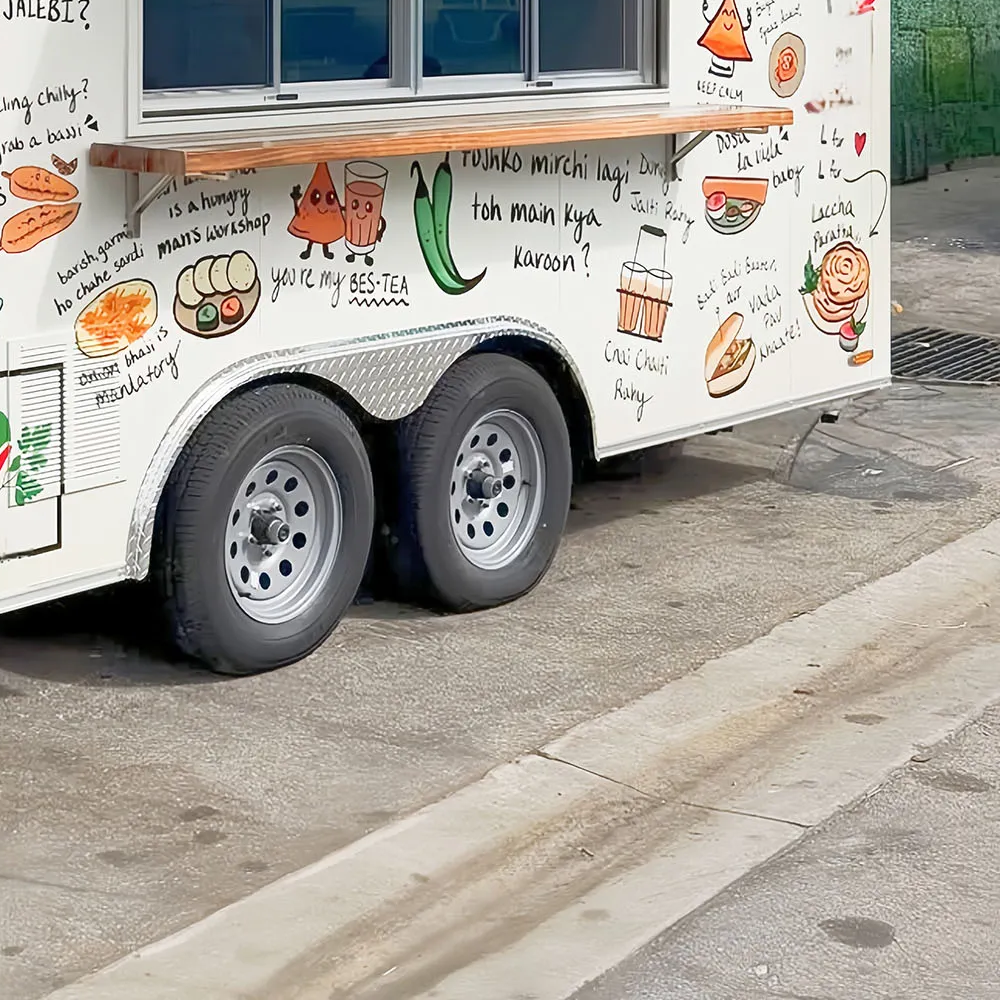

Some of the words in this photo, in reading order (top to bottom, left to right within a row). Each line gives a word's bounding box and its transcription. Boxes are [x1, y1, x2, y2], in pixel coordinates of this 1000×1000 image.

[37, 78, 89, 113] chilly?
[29, 136, 42, 148] a
[531, 149, 588, 180] mirchi
[597, 156, 630, 202] lagi
[169, 202, 183, 218] is
[188, 200, 200, 214] a
[200, 187, 251, 217] hungry
[472, 191, 502, 221] toh
[511, 202, 555, 226] main
[53, 298, 73, 316] ho
[114, 242, 144, 273] sardi
[319, 270, 346, 308] my
[157, 325, 169, 342] is
